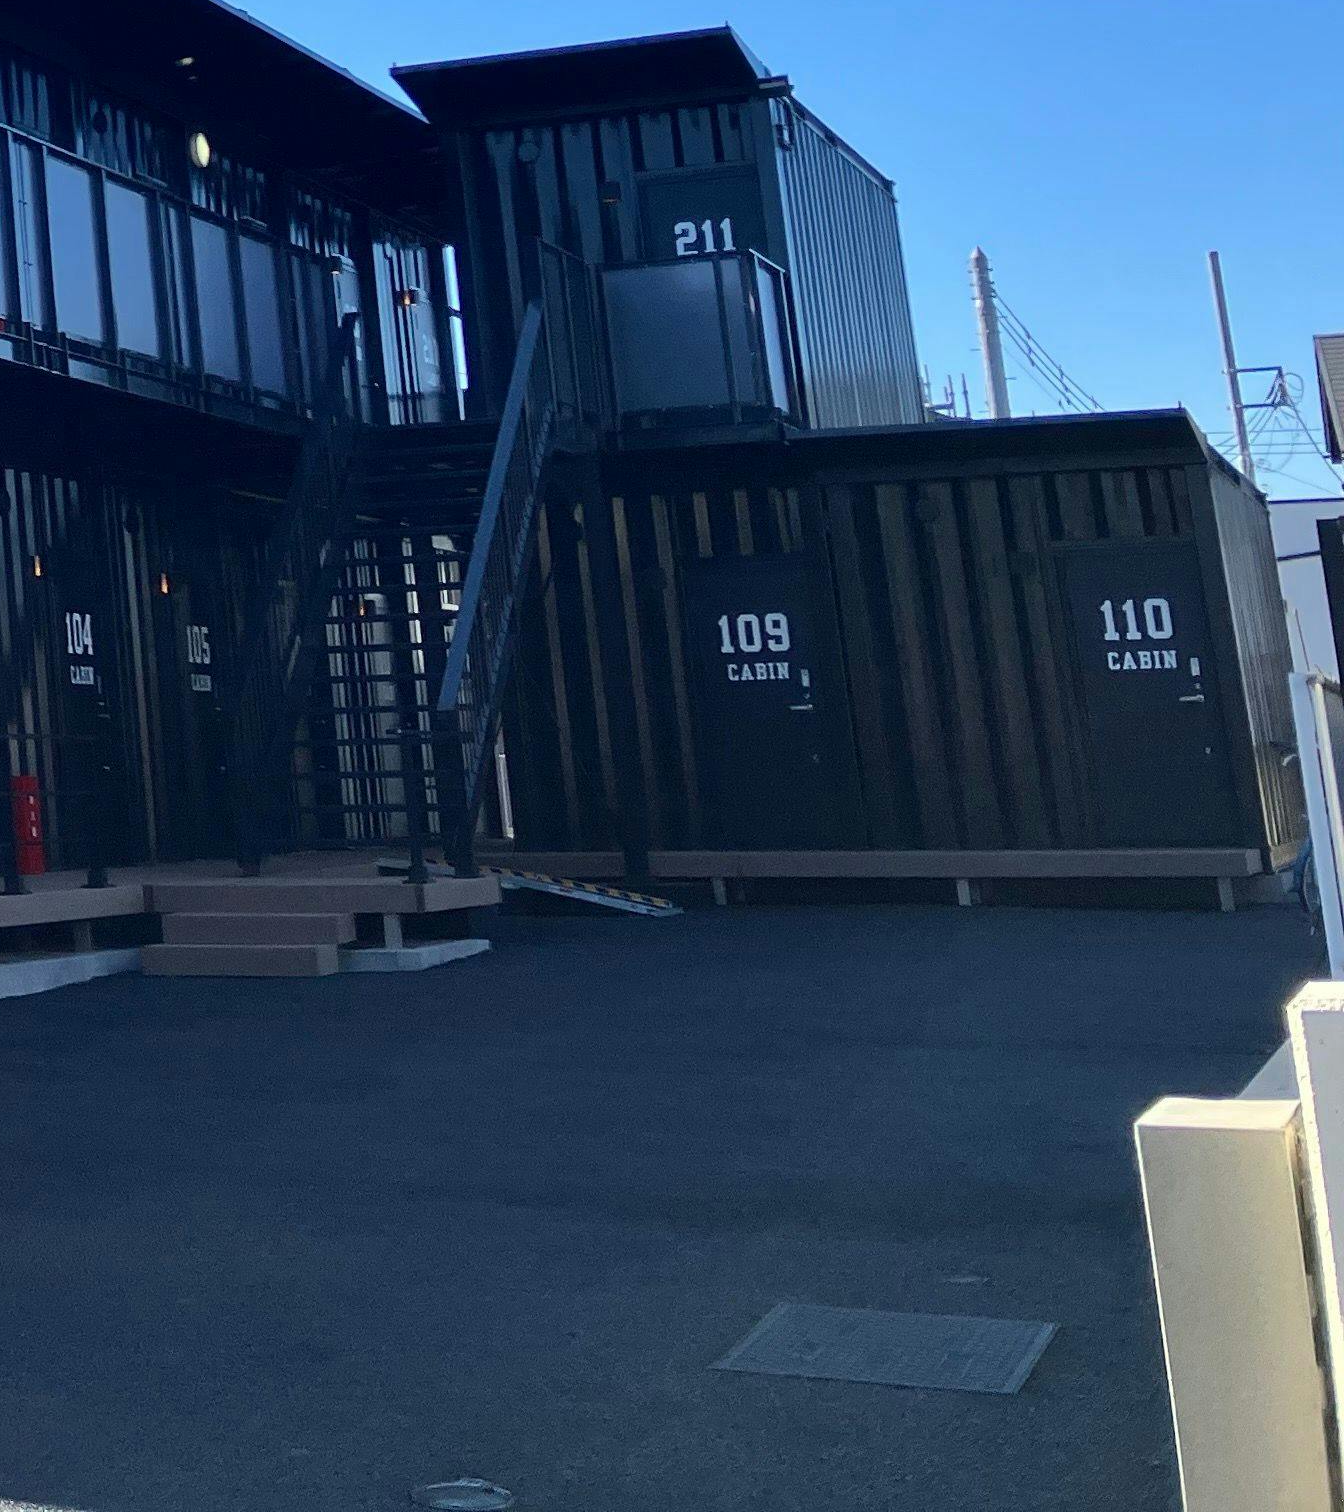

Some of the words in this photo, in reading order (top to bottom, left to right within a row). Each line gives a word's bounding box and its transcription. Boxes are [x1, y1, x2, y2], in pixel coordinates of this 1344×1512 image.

[674, 217, 736, 256] 211
[65, 612, 94, 655] 104
[718, 613, 790, 653] 109
[1100, 598, 1173, 640] 110
[186, 625, 211, 664] 105
[1107, 650, 1177, 670] CABIN
[727, 662, 790, 681] CABIN
